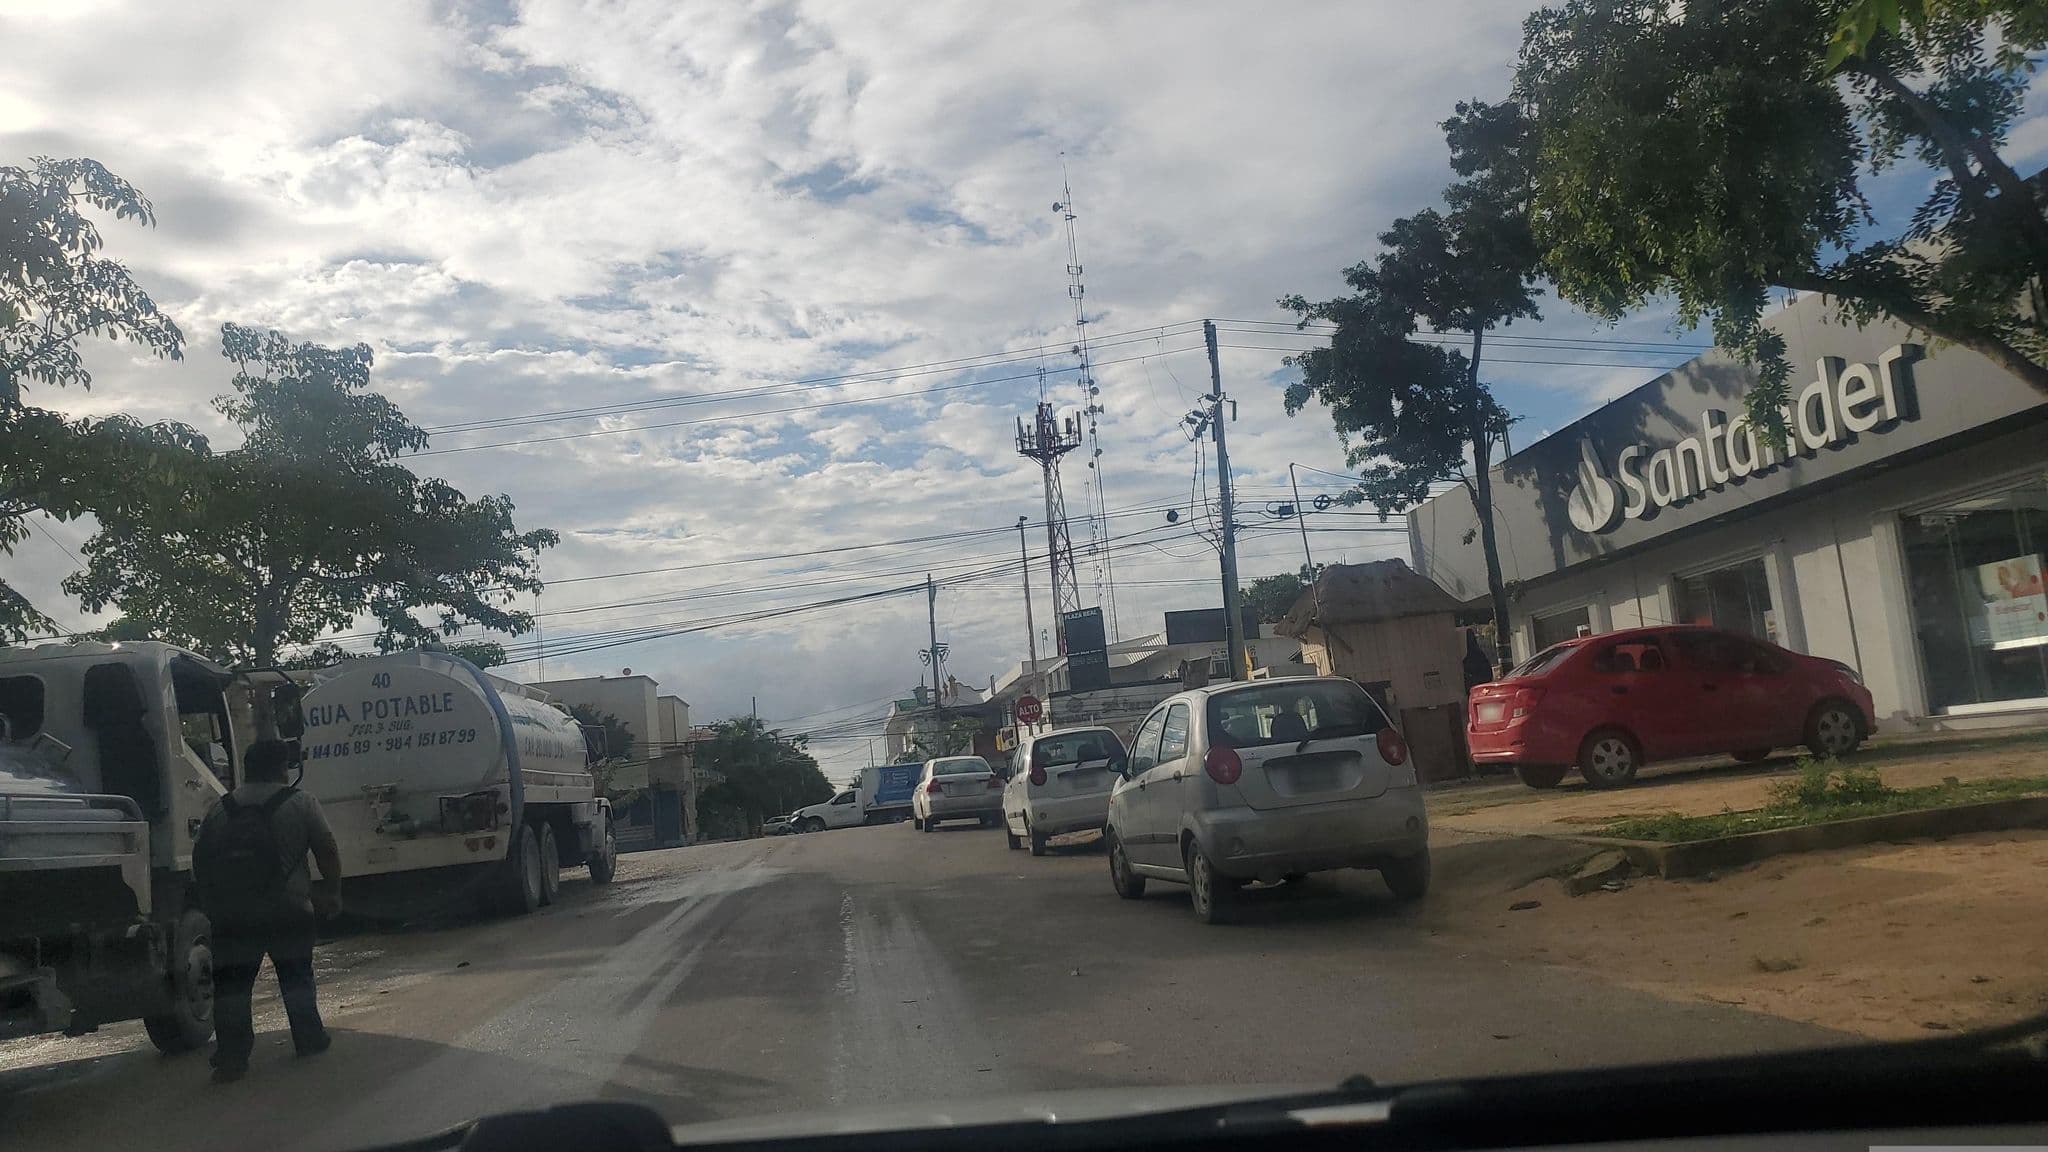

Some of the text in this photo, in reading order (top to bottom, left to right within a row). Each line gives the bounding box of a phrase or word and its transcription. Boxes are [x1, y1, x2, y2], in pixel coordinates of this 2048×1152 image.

[1618, 344, 1913, 519] Santander
[371, 672, 391, 688] 40
[362, 692, 453, 720] POTABLE
[1019, 704, 1039, 716] ALTO
